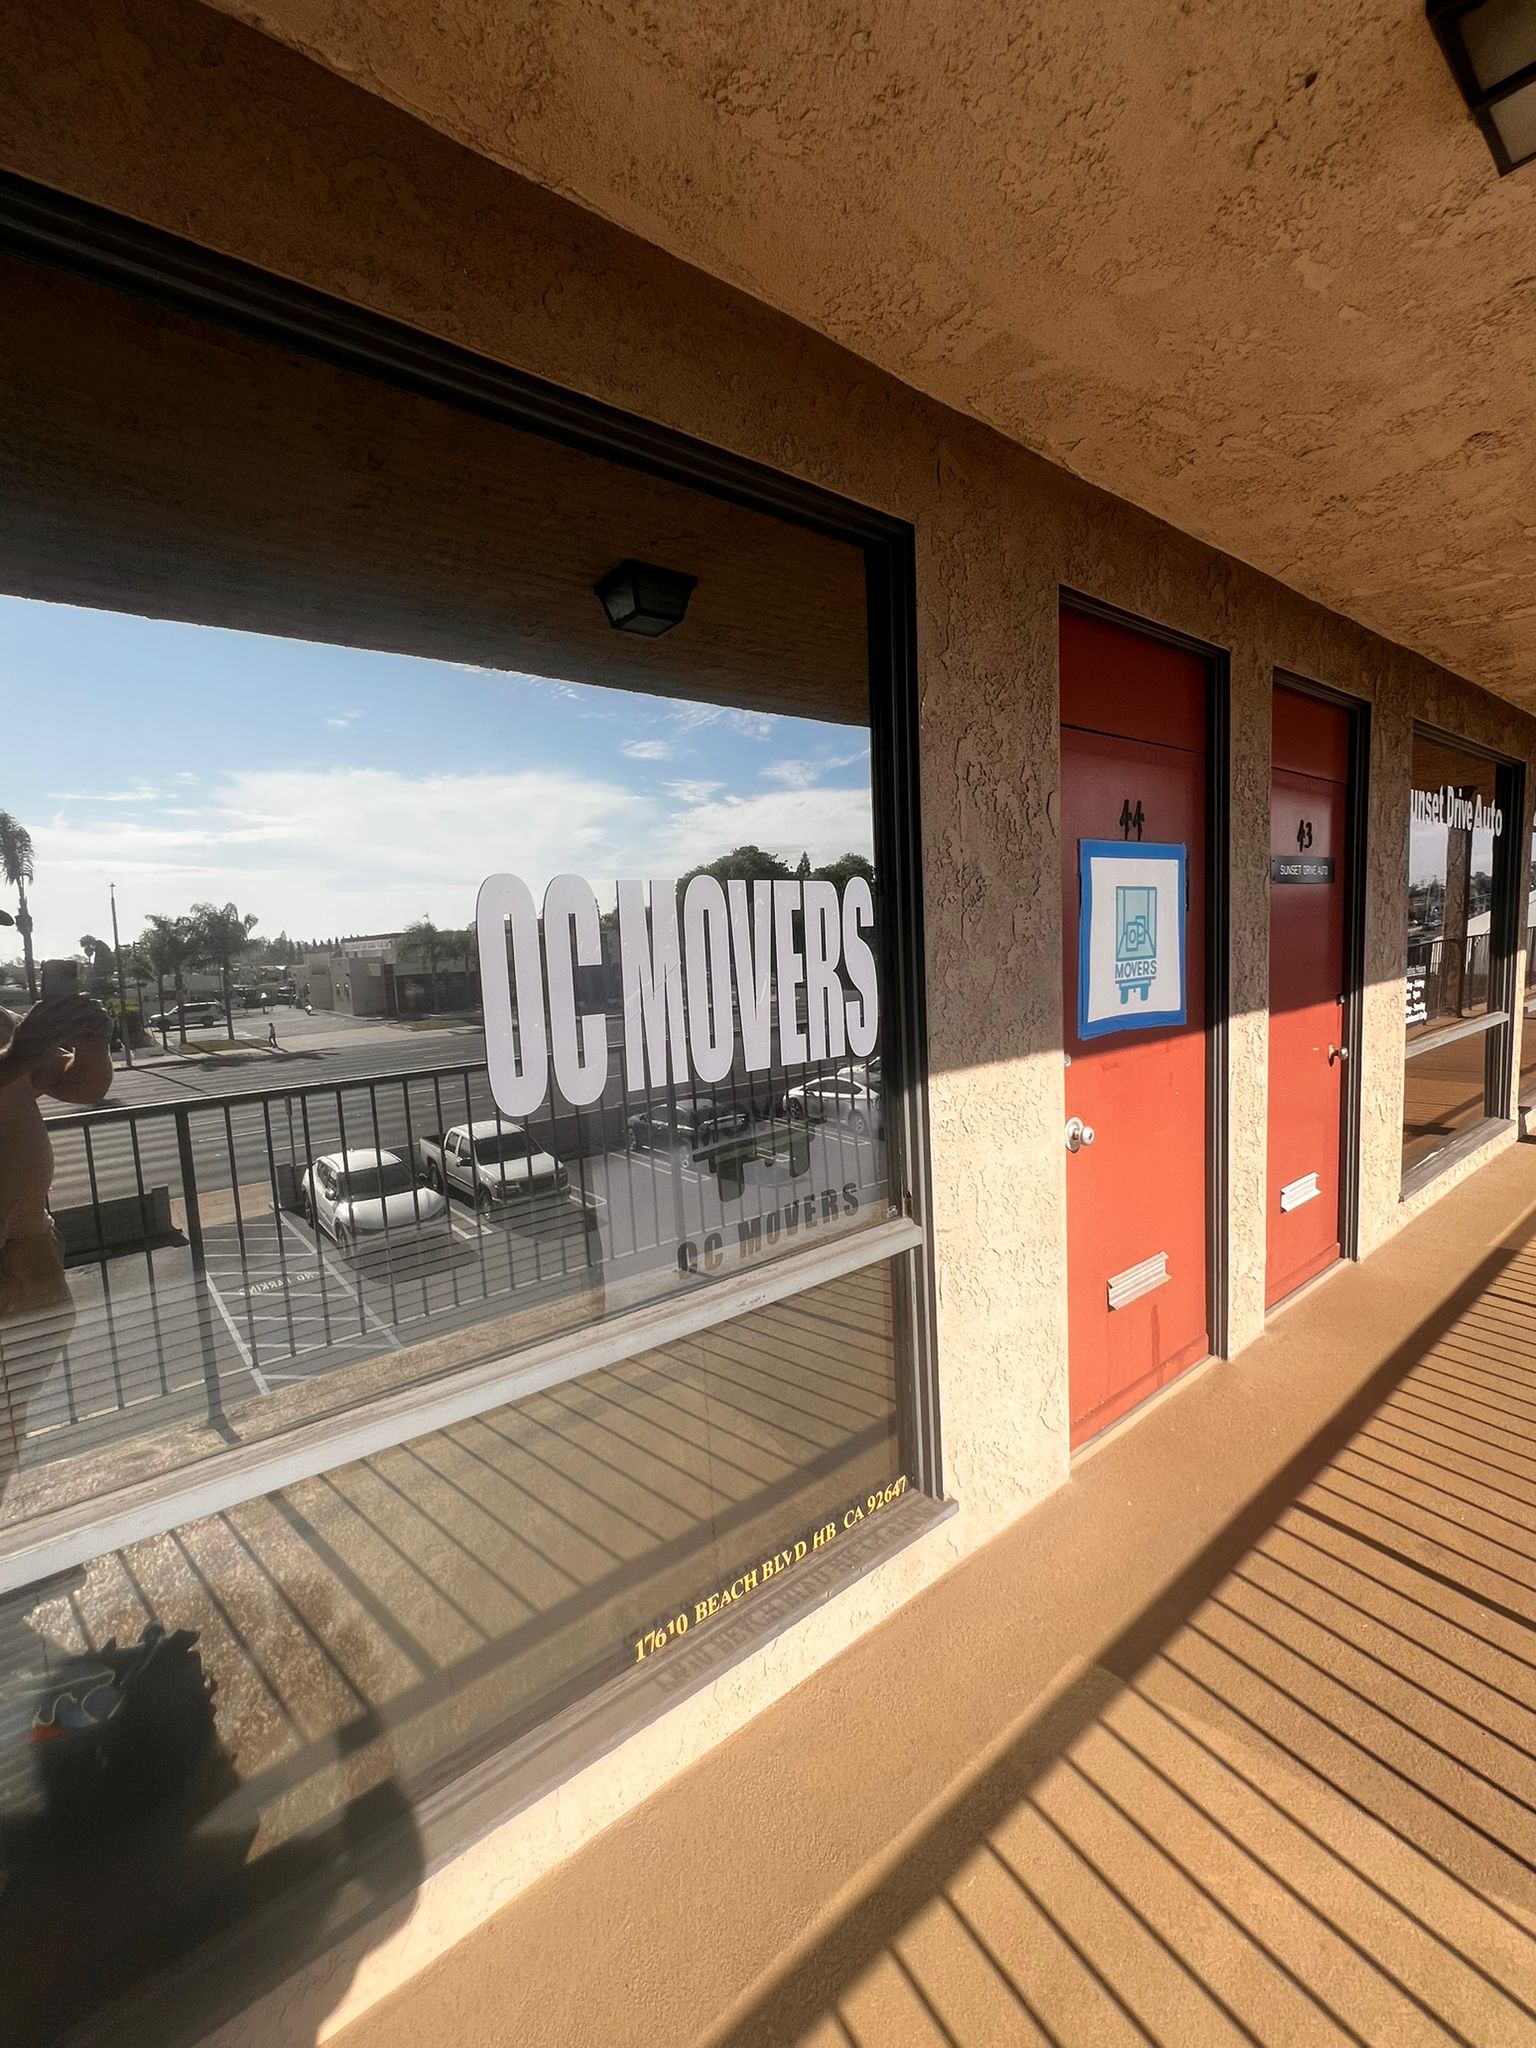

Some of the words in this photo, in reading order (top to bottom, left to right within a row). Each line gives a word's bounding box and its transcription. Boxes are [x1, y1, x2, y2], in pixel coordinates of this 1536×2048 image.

[1120, 799, 1145, 841] 44
[1410, 785, 1443, 825] unset
[1447, 785, 1473, 831] Drive
[1474, 794, 1502, 837] Auto
[1296, 819, 1312, 852] 43
[1280, 864, 1302, 876] SUNSET
[1115, 960, 1157, 980] MOVERS
[476, 873, 608, 1117] OC
[616, 875, 878, 1092] MOVERS
[677, 1232, 723, 1280] OC
[738, 1183, 859, 1259] MOVERS
[634, 1613, 689, 1663] 17610
[694, 1568, 758, 1624] BEACH
[761, 1540, 808, 1582] BLVD
[812, 1521, 838, 1551] HB
[843, 1505, 865, 1530] CA
[866, 1474, 907, 1515] 92647
